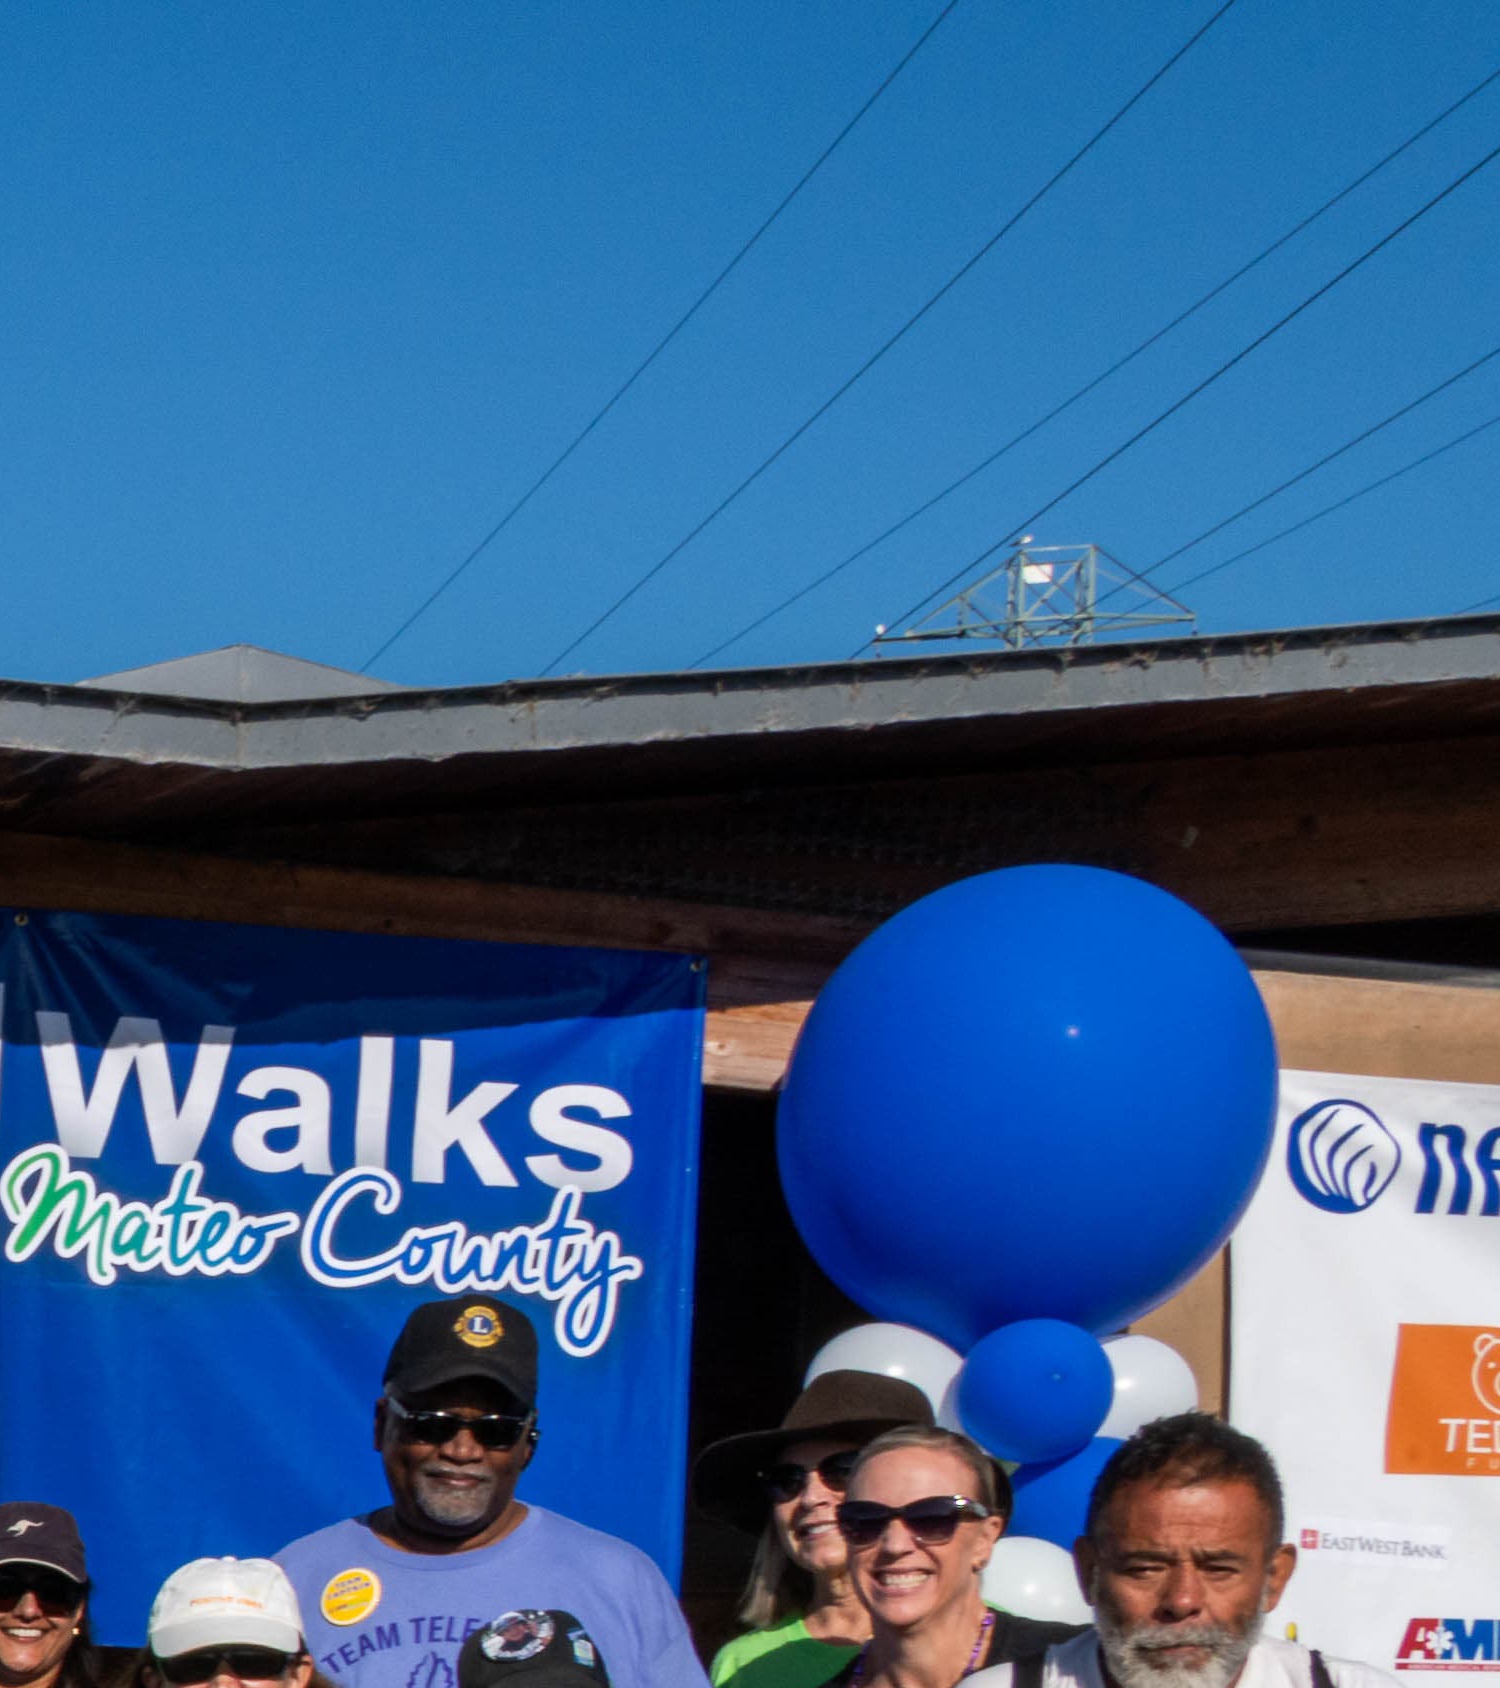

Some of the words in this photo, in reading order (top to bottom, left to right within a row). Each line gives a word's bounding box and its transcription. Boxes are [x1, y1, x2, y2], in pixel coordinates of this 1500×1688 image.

[0, 1144, 298, 1285] Mateo
[301, 1166, 643, 1357] County
[319, 1622, 400, 1674] TEAM
